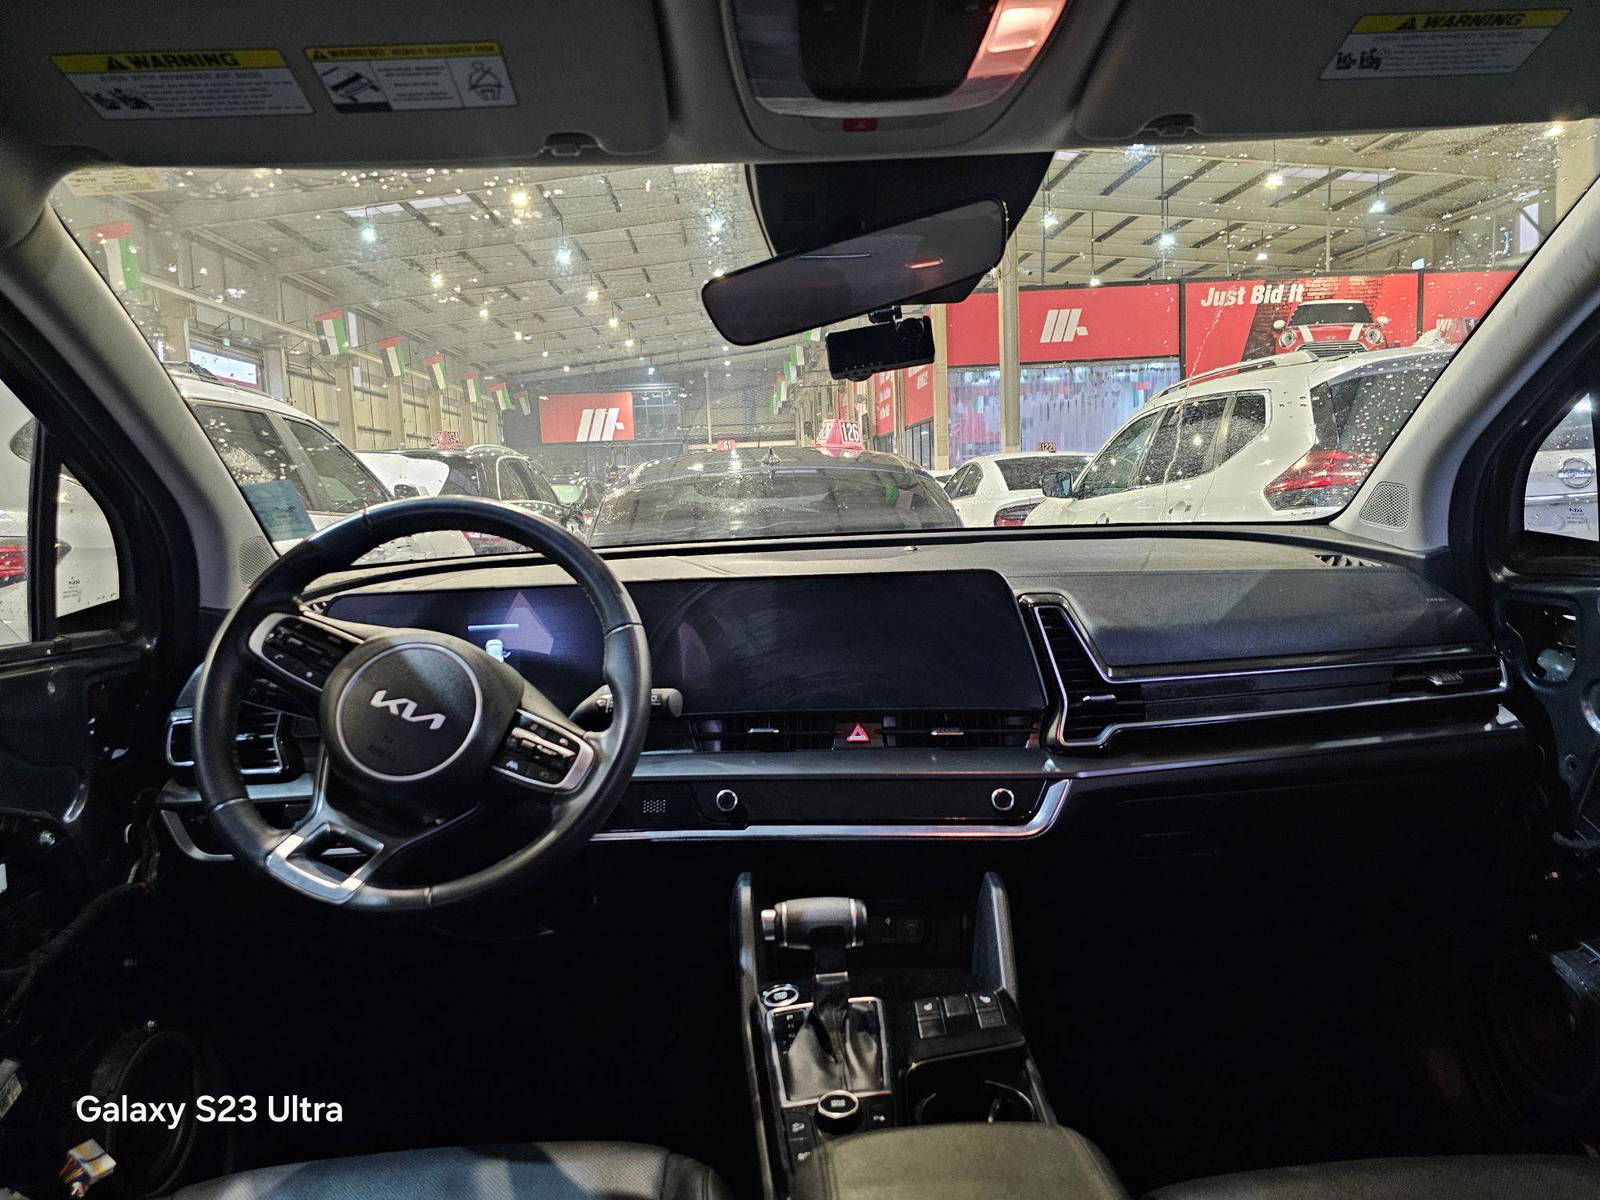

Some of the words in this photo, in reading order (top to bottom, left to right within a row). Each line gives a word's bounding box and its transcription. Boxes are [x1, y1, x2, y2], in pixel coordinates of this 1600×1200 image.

[1421, 13, 1524, 29] WARNING
[127, 53, 240, 69] WARNING
[1200, 285, 1247, 307] Just
[1250, 283, 1285, 305] Bid
[1288, 282, 1305, 303] It
[841, 422, 860, 442] 126
